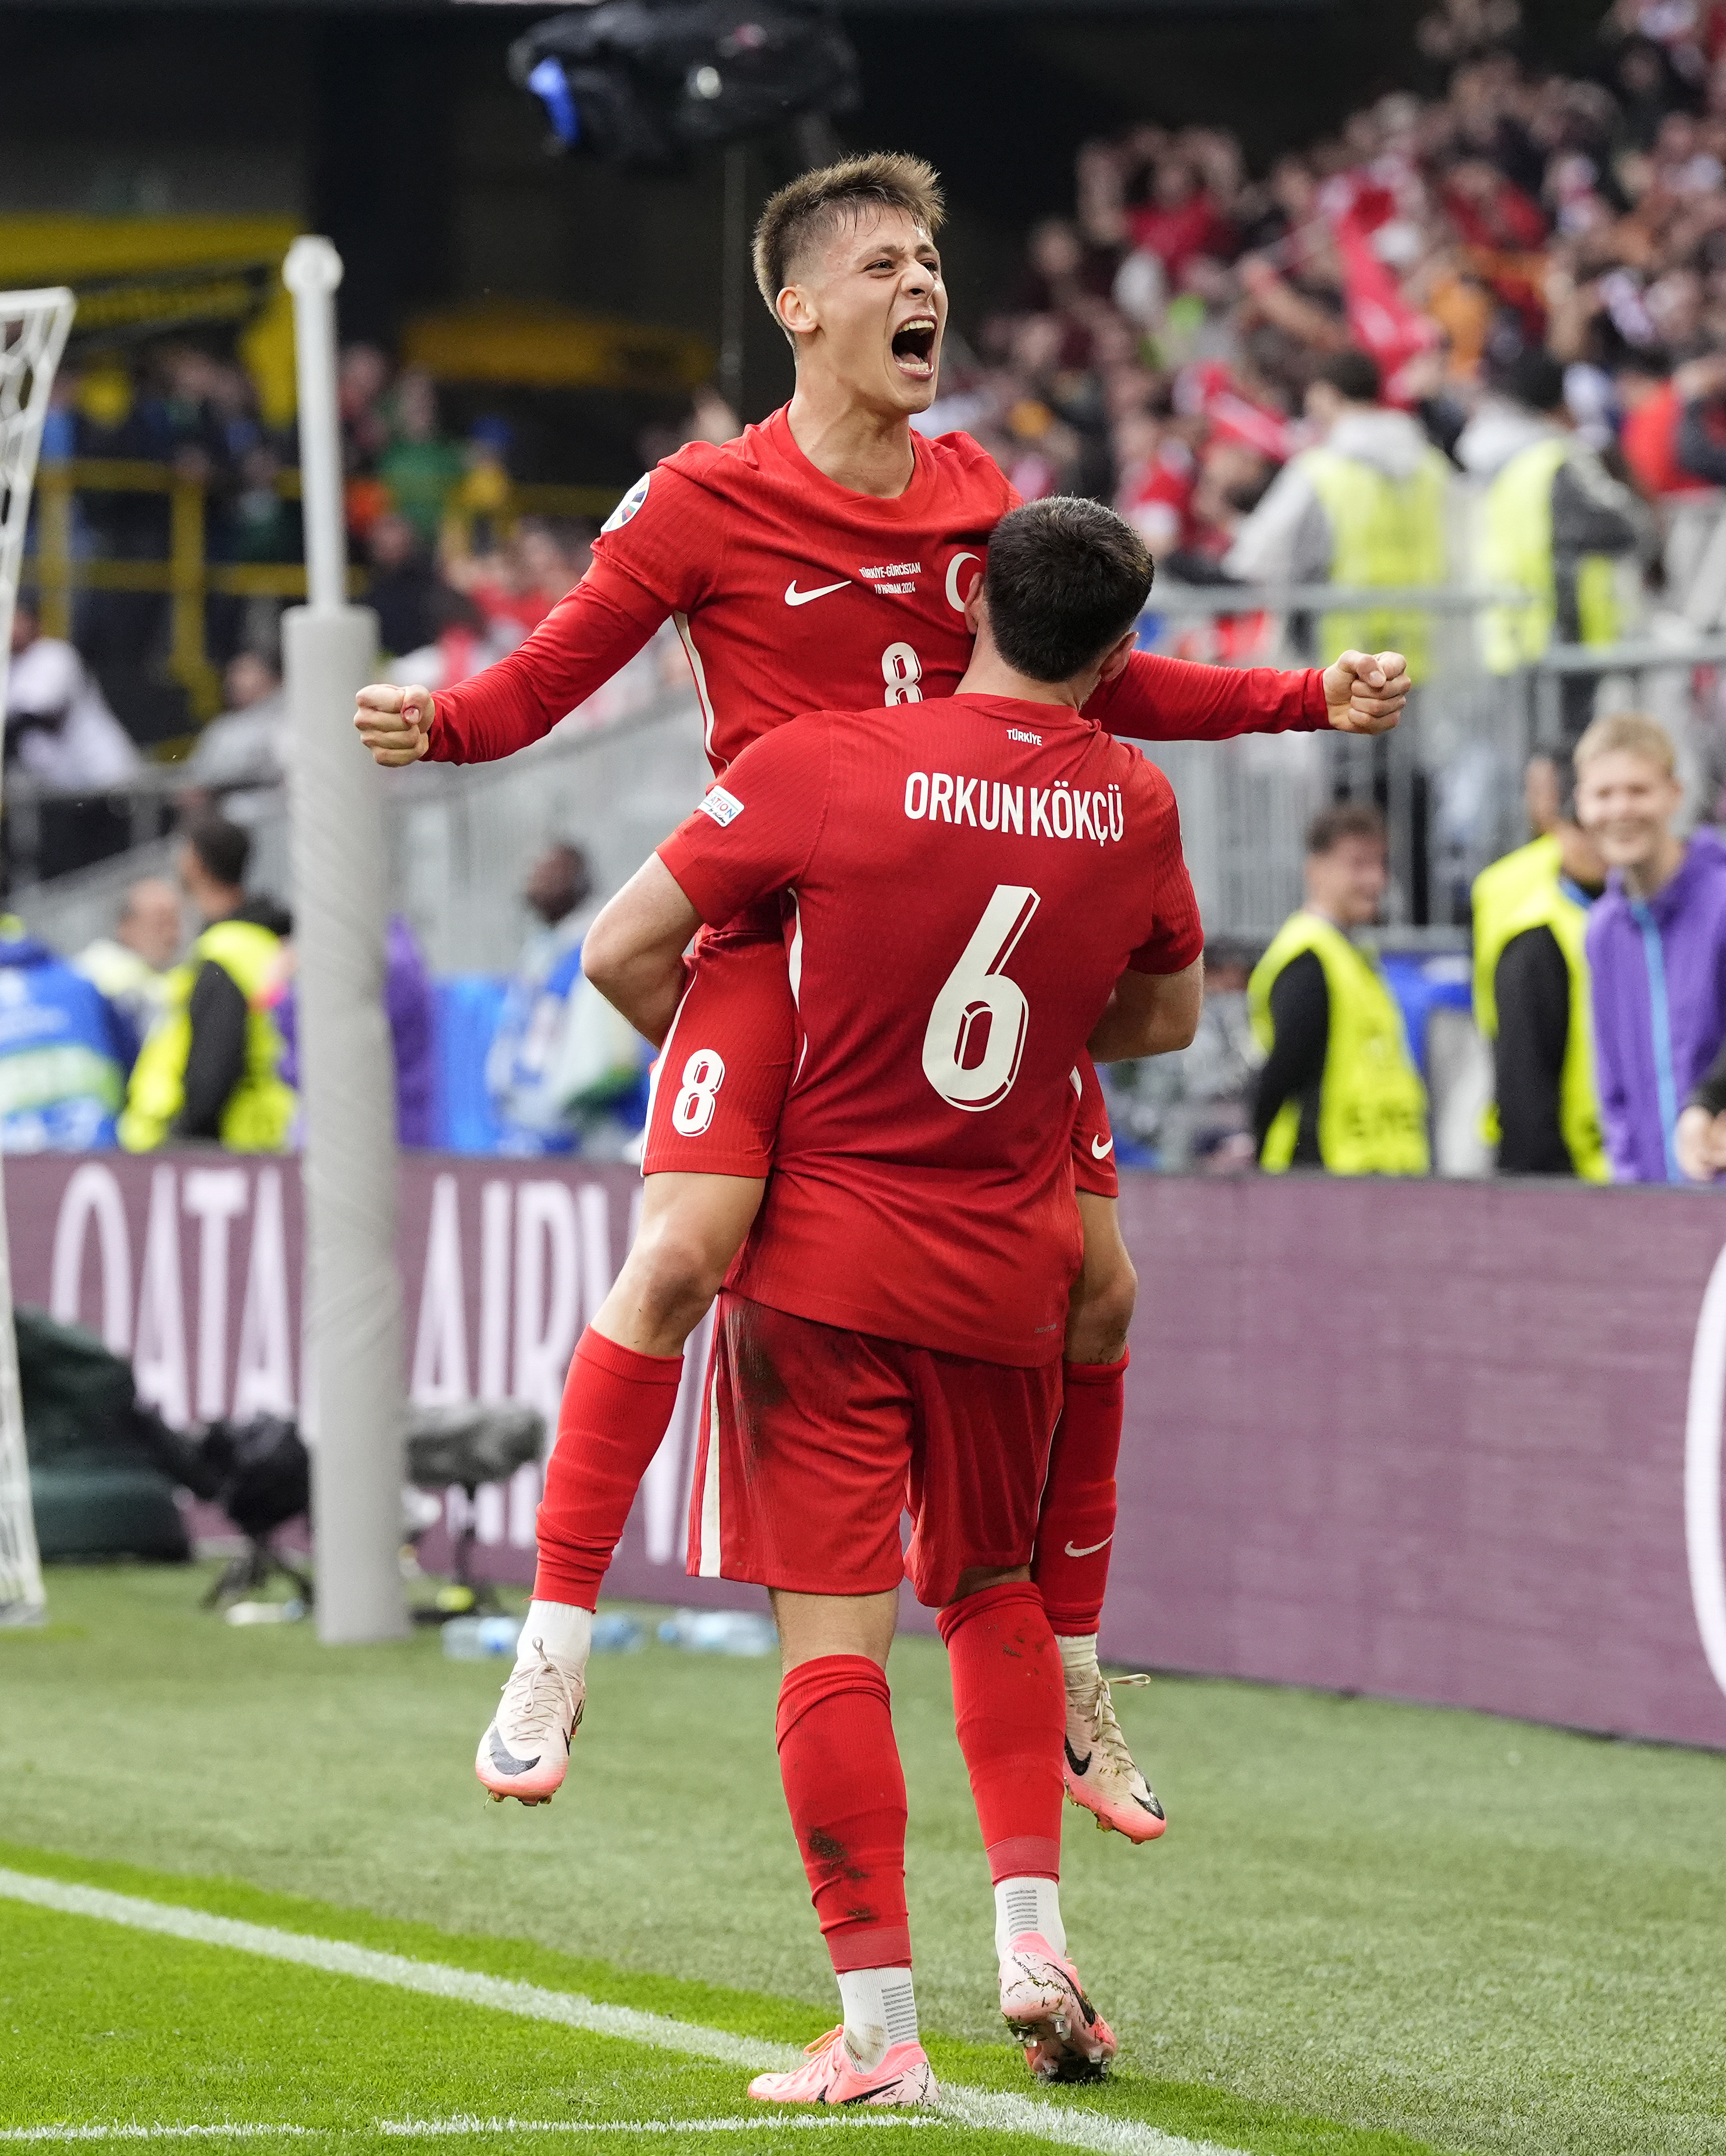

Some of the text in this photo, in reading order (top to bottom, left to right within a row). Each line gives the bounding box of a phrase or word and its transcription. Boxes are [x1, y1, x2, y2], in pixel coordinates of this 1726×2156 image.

[874, 583, 882, 594] 18
[902, 581, 916, 593] 2024
[881, 642, 923, 707] 8
[1006, 728, 1042, 746] TÜRKİYE
[707, 794, 736, 818] ATION
[904, 771, 1124, 847] ORKUN KÖKÇÜ
[922, 884, 1041, 1112] 6
[671, 1048, 726, 1137] 8
